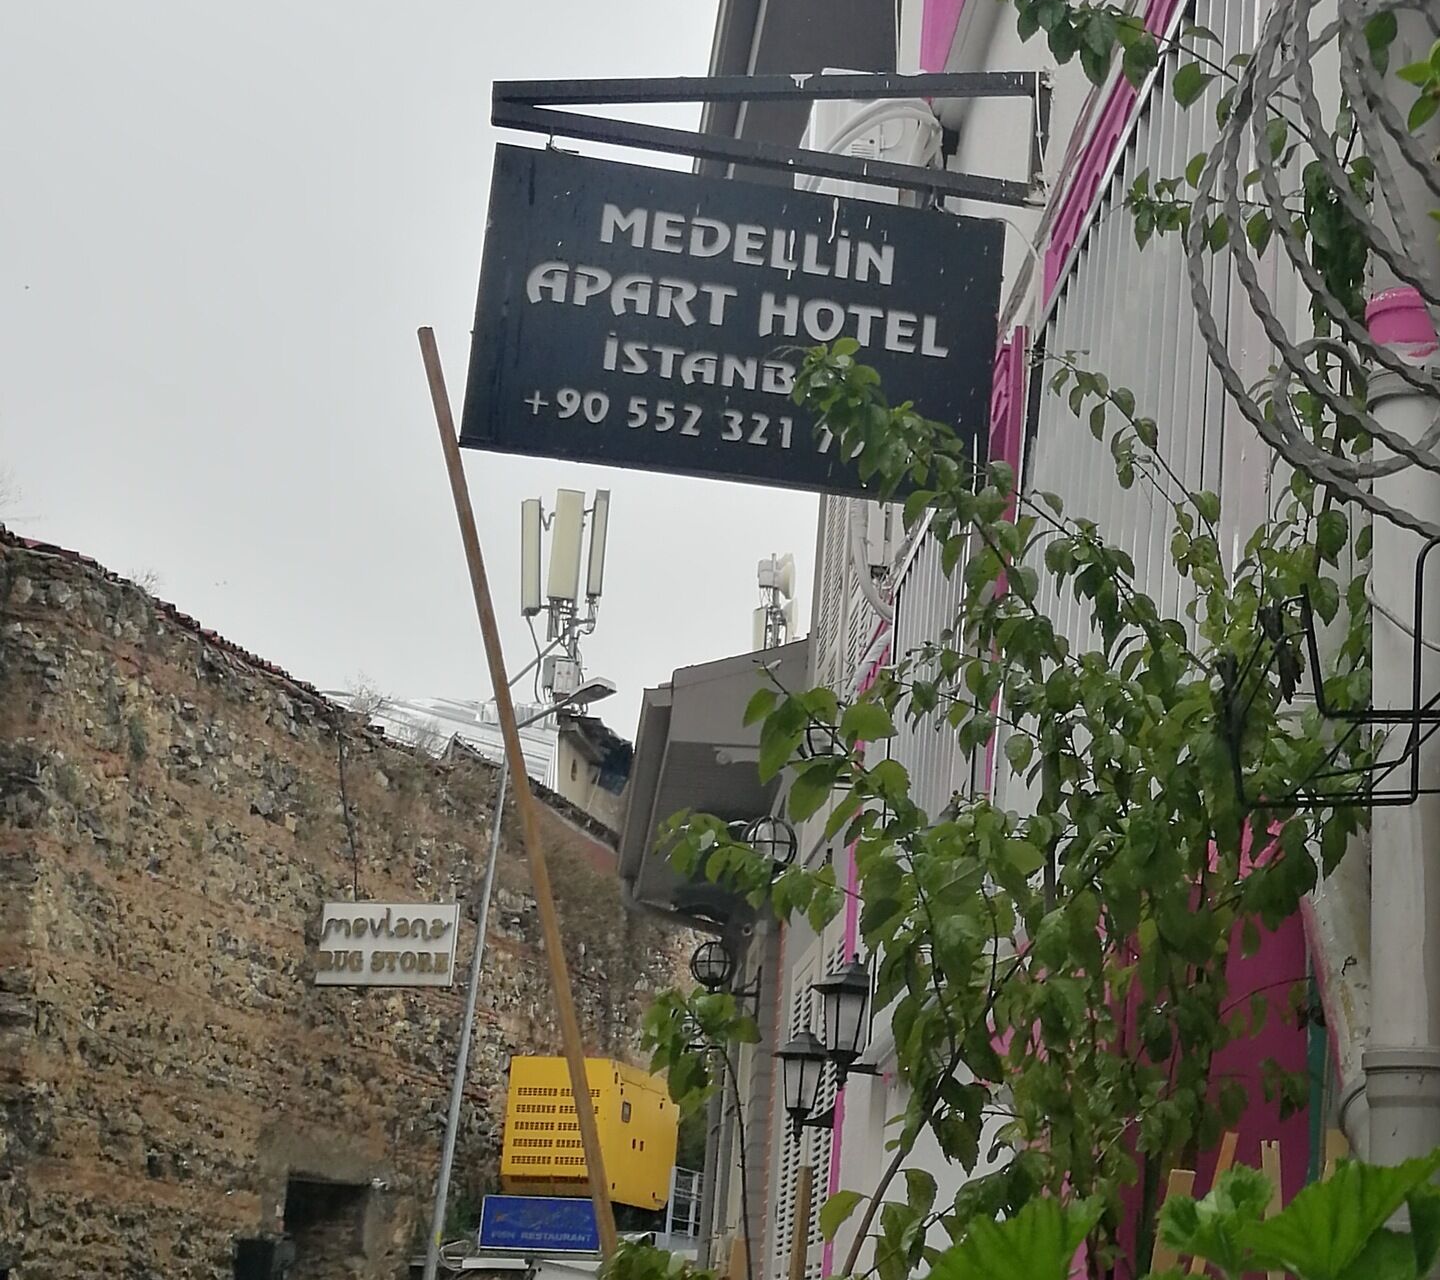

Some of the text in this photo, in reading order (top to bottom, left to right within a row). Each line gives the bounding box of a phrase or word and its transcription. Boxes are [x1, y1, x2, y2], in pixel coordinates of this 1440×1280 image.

[526, 260, 950, 358] APART HOTEL
[602, 331, 796, 395] İSTANB
[523, 387, 610, 424] +90
[627, 395, 703, 437] 552
[721, 409, 793, 449] 321
[370, 950, 450, 974] STORE
[520, 1231, 593, 1242] RESTAURANT
